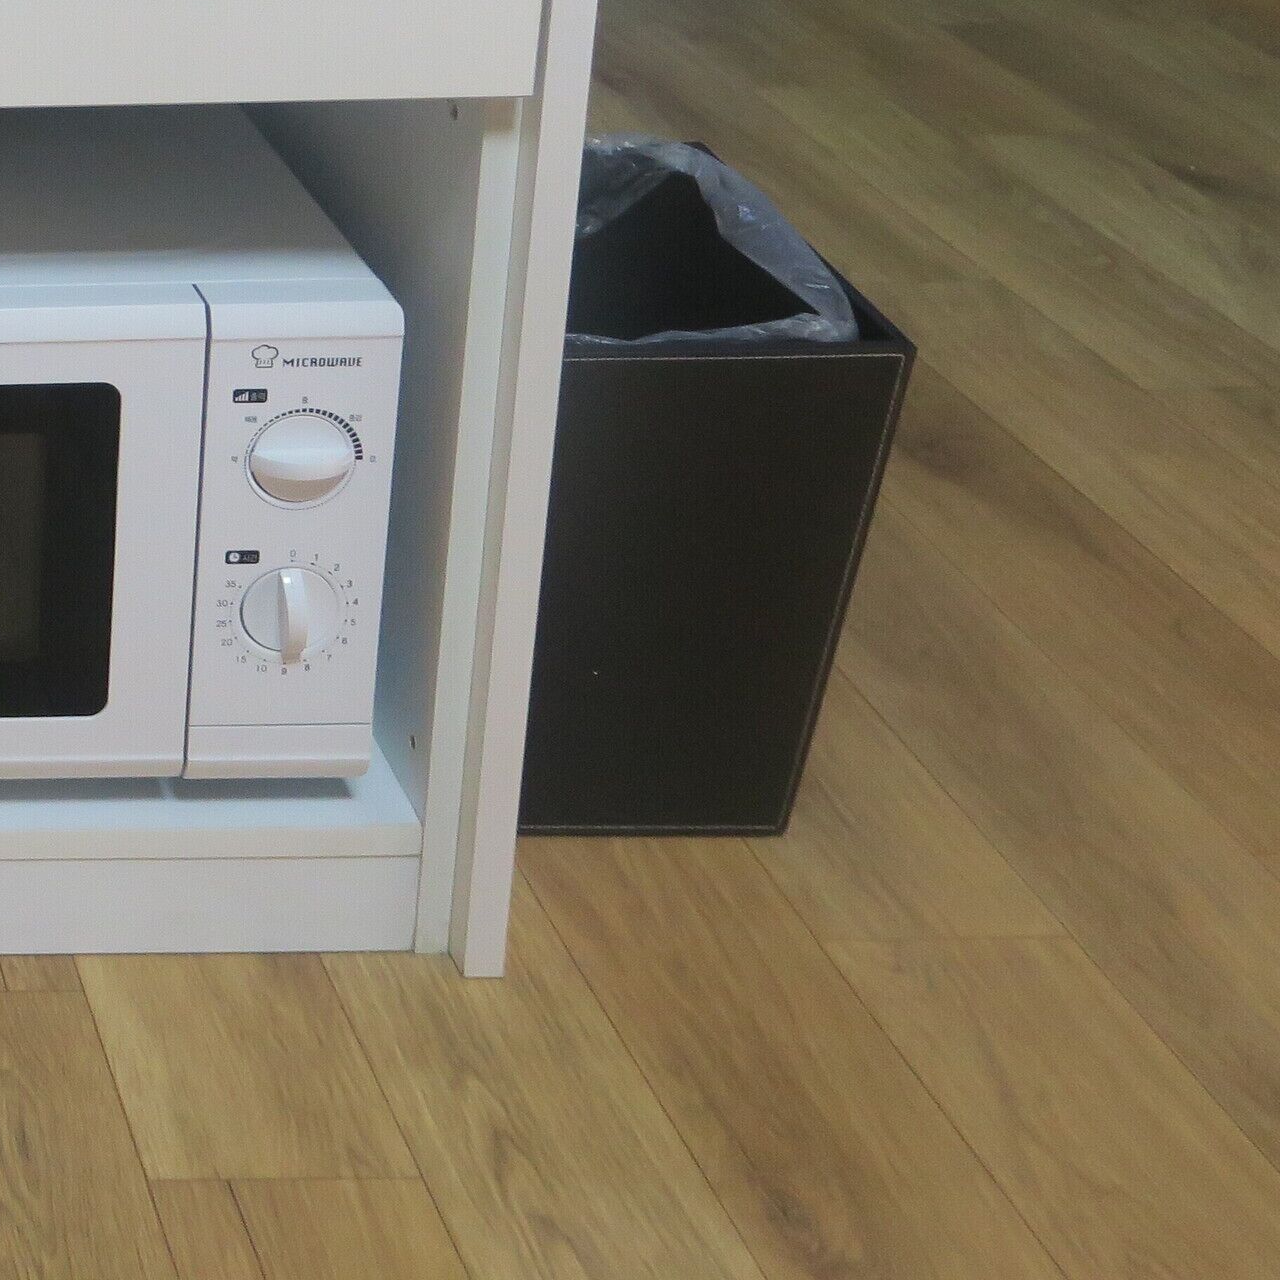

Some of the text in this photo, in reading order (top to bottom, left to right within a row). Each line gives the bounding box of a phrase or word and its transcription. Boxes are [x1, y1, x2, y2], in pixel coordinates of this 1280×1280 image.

[283, 357, 363, 367] MICROWAVE
[333, 563, 340, 572] 2
[225, 580, 237, 588] 35
[346, 579, 353, 588] 3
[216, 599, 228, 608] 30
[216, 620, 227, 628] 25
[221, 639, 233, 647] 20
[236, 655, 247, 663] 15
[281, 667, 287, 675] 9
